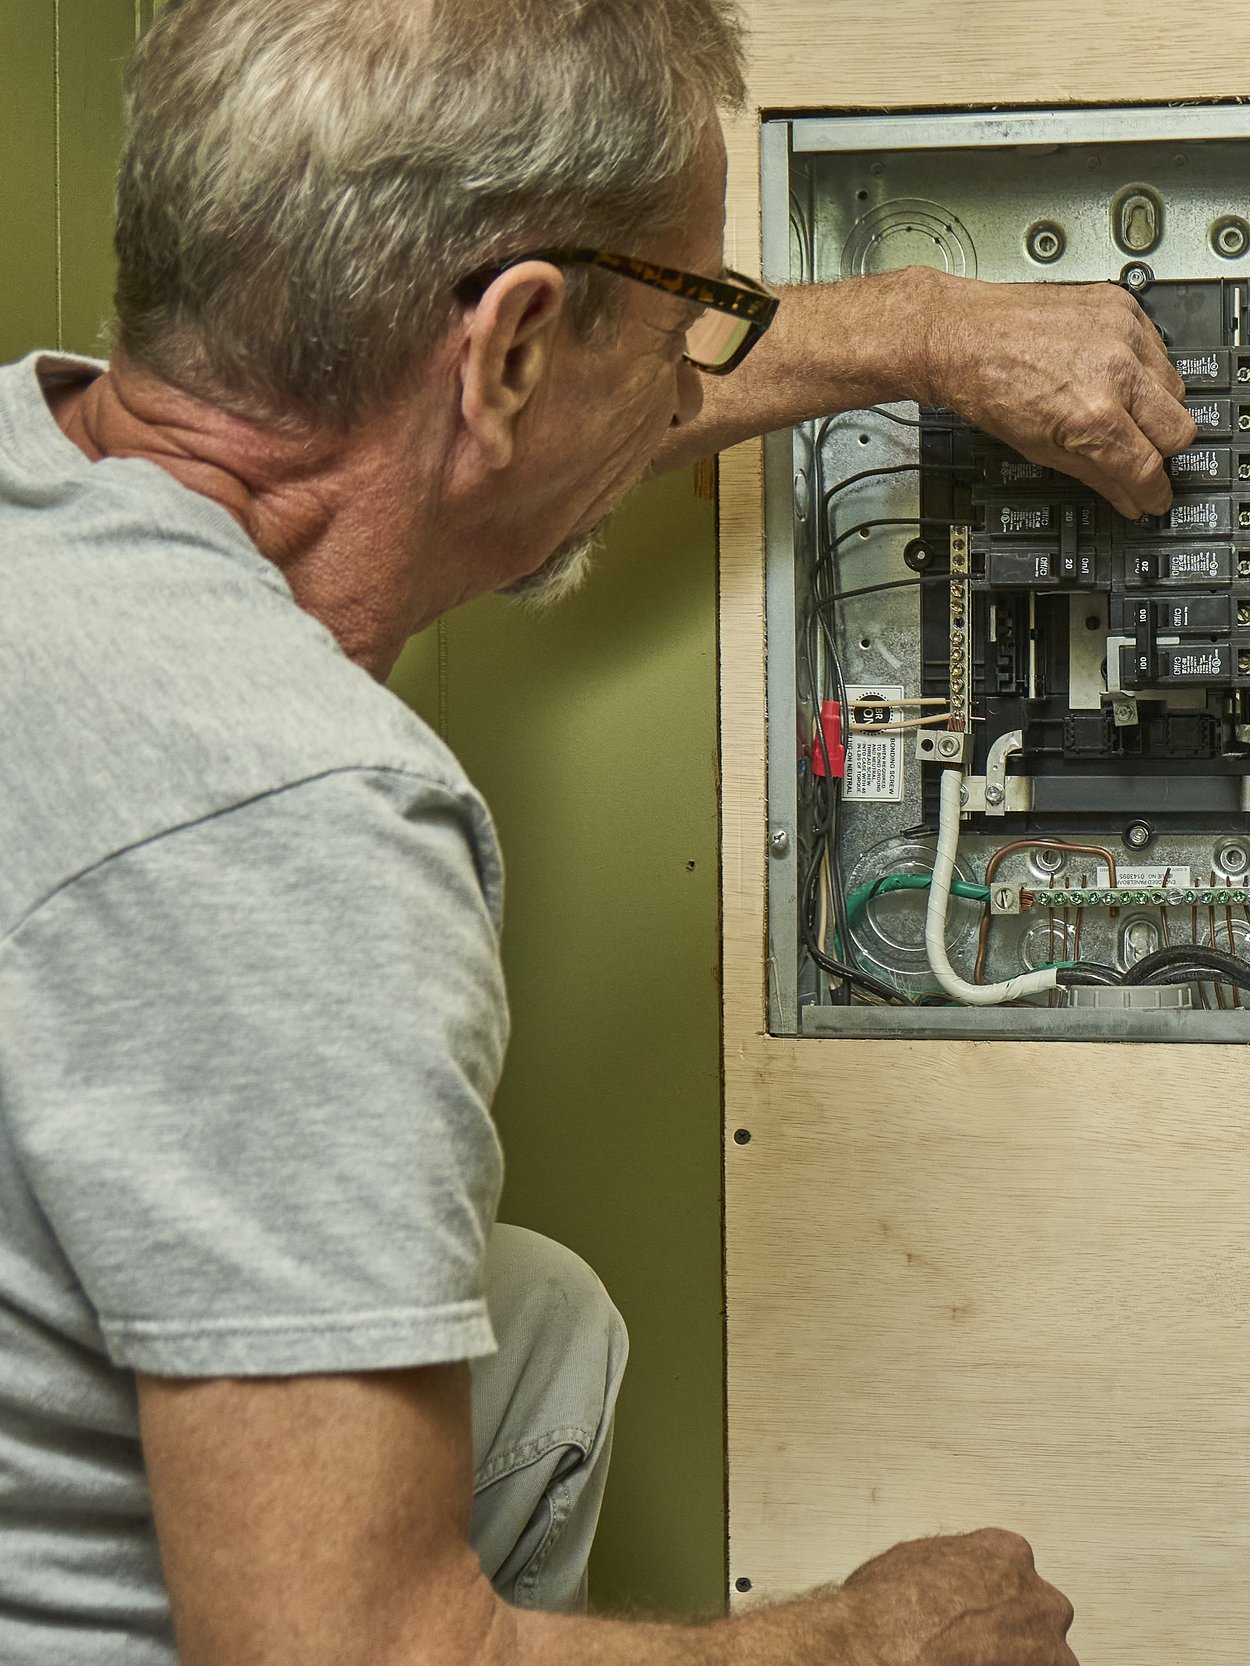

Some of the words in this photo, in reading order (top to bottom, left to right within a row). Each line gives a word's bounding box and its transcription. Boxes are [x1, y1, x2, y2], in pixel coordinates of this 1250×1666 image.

[1065, 511, 1073, 521] 20
[1065, 559, 1073, 569] 20
[1141, 561, 1149, 572] 20
[875, 708, 883, 720] BR
